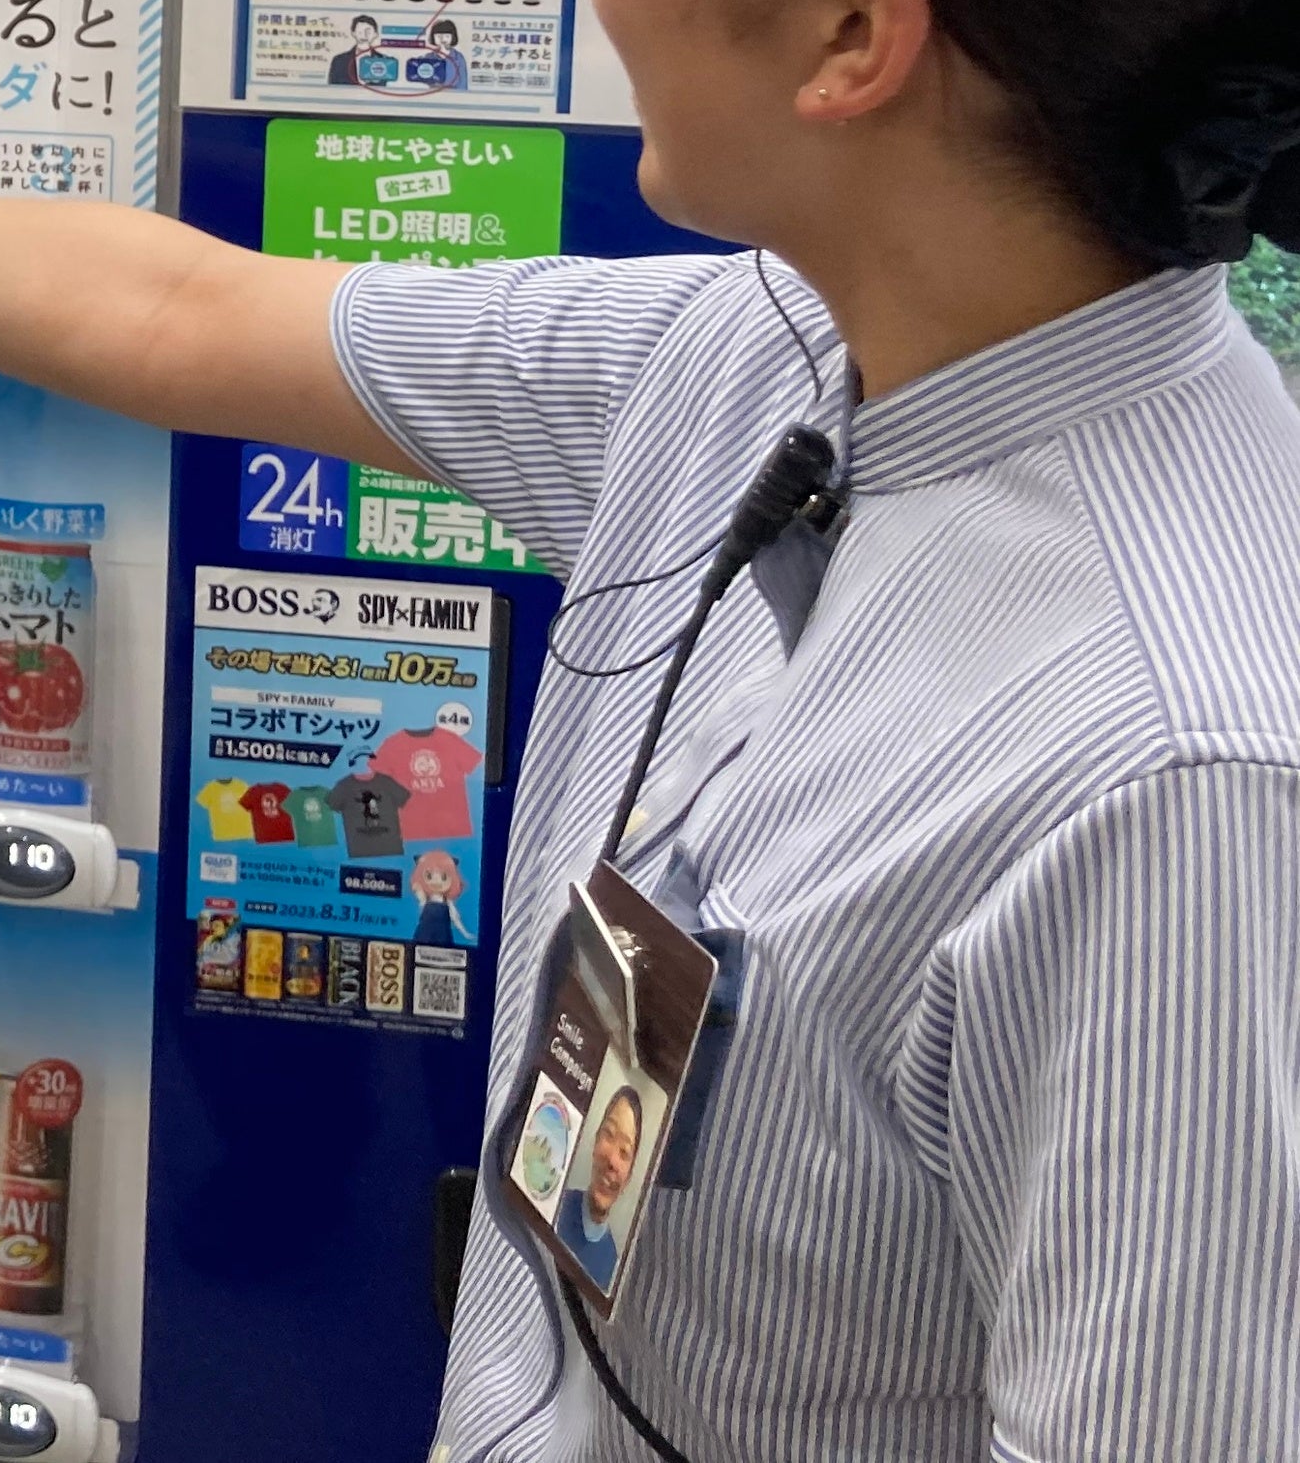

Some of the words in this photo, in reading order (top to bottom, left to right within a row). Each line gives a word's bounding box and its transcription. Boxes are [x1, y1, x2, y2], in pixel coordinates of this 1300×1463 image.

[315, 133, 514, 167] 地球にやさしい
[383, 175, 446, 198] 省エネ!
[312, 206, 508, 246] LED照明&
[246, 452, 344, 529] 24h
[269, 526, 315, 553] 消灯
[207, 583, 299, 618] BOSS
[205, 645, 360, 680] その場で当たる!
[210, 706, 381, 741] コラボTシャツ
[10, 844, 54, 870] 110
[380, 945, 401, 1007] BOSS
